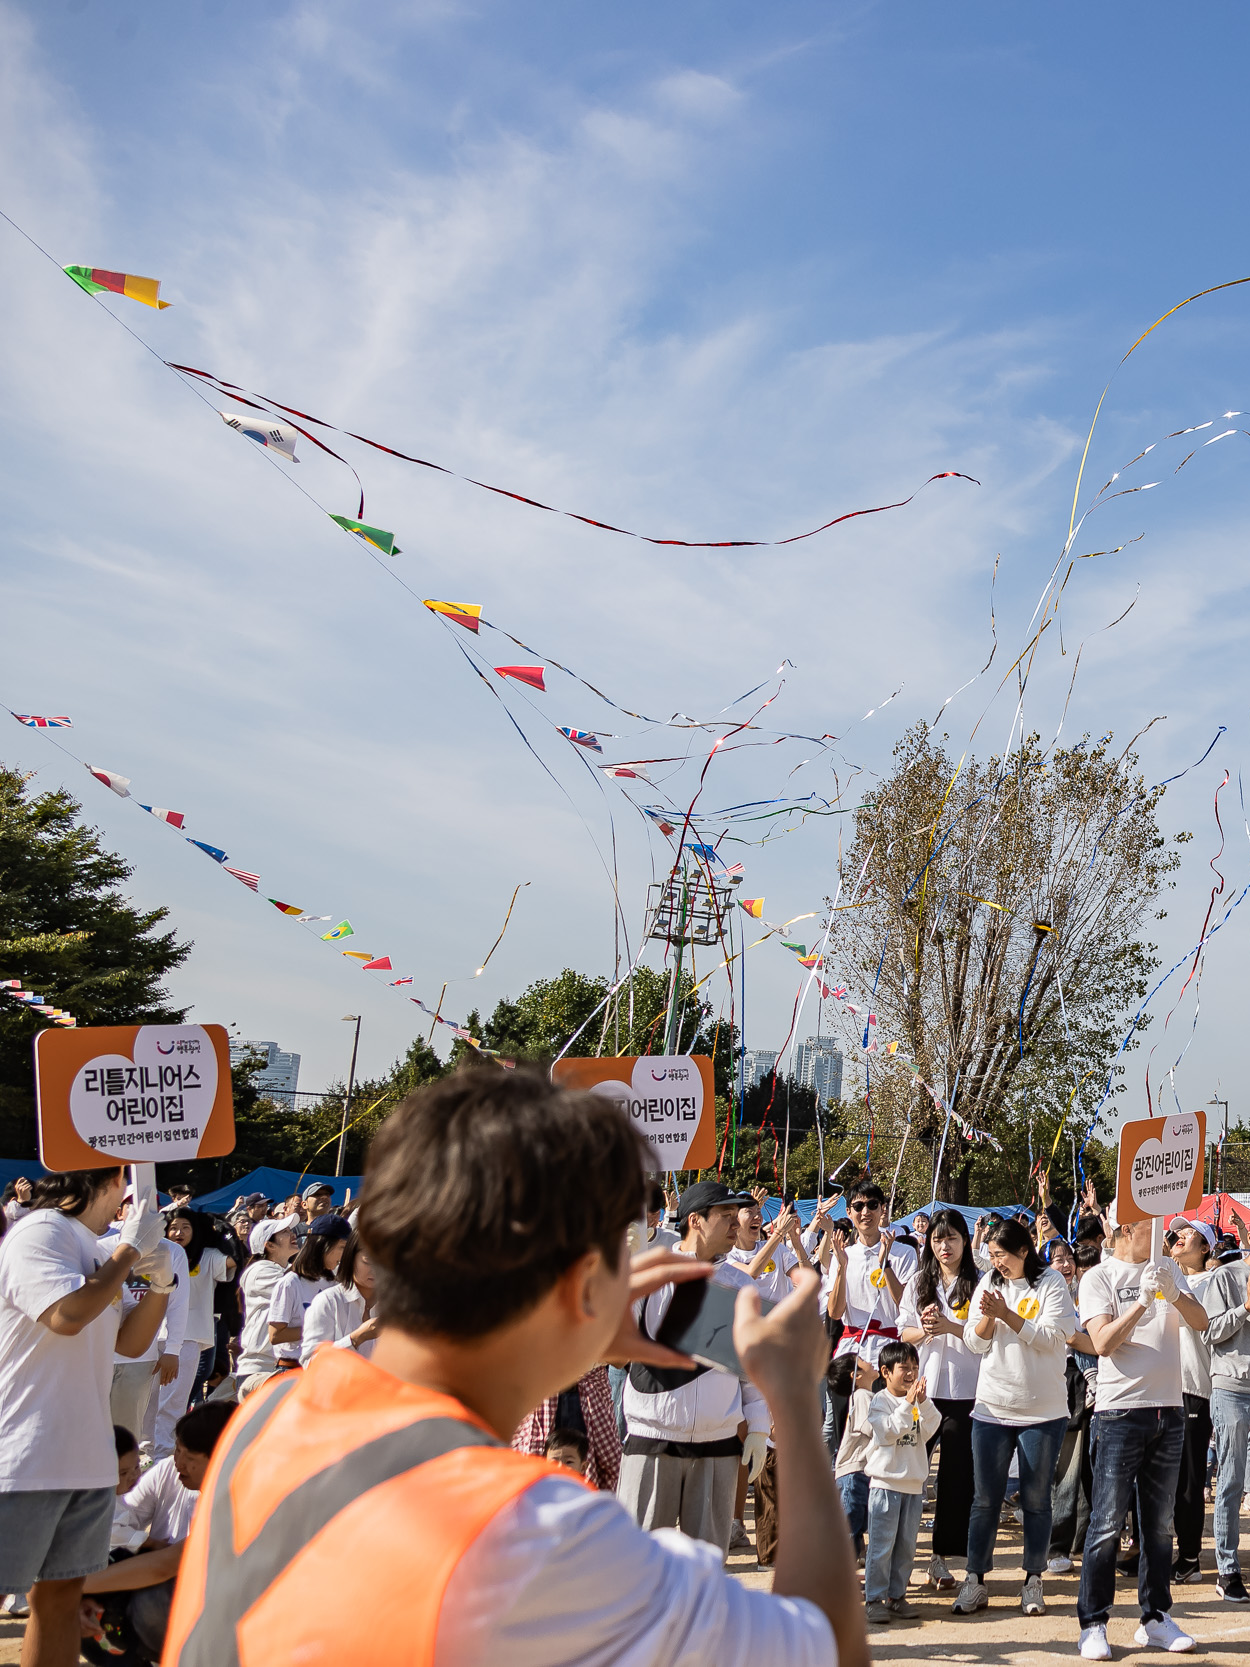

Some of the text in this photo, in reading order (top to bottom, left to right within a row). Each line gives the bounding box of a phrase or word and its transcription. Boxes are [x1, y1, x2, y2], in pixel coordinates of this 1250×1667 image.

[84, 1064, 202, 1097] 리틀지니어스
[106, 1095, 185, 1126] 어린이집
[88, 1127, 199, 1149] 광진구민간어린이집연합회
[1134, 1147, 1194, 1182] 광진어린이집
[1138, 1179, 1189, 1198] 광진구민간어린이집연합회
